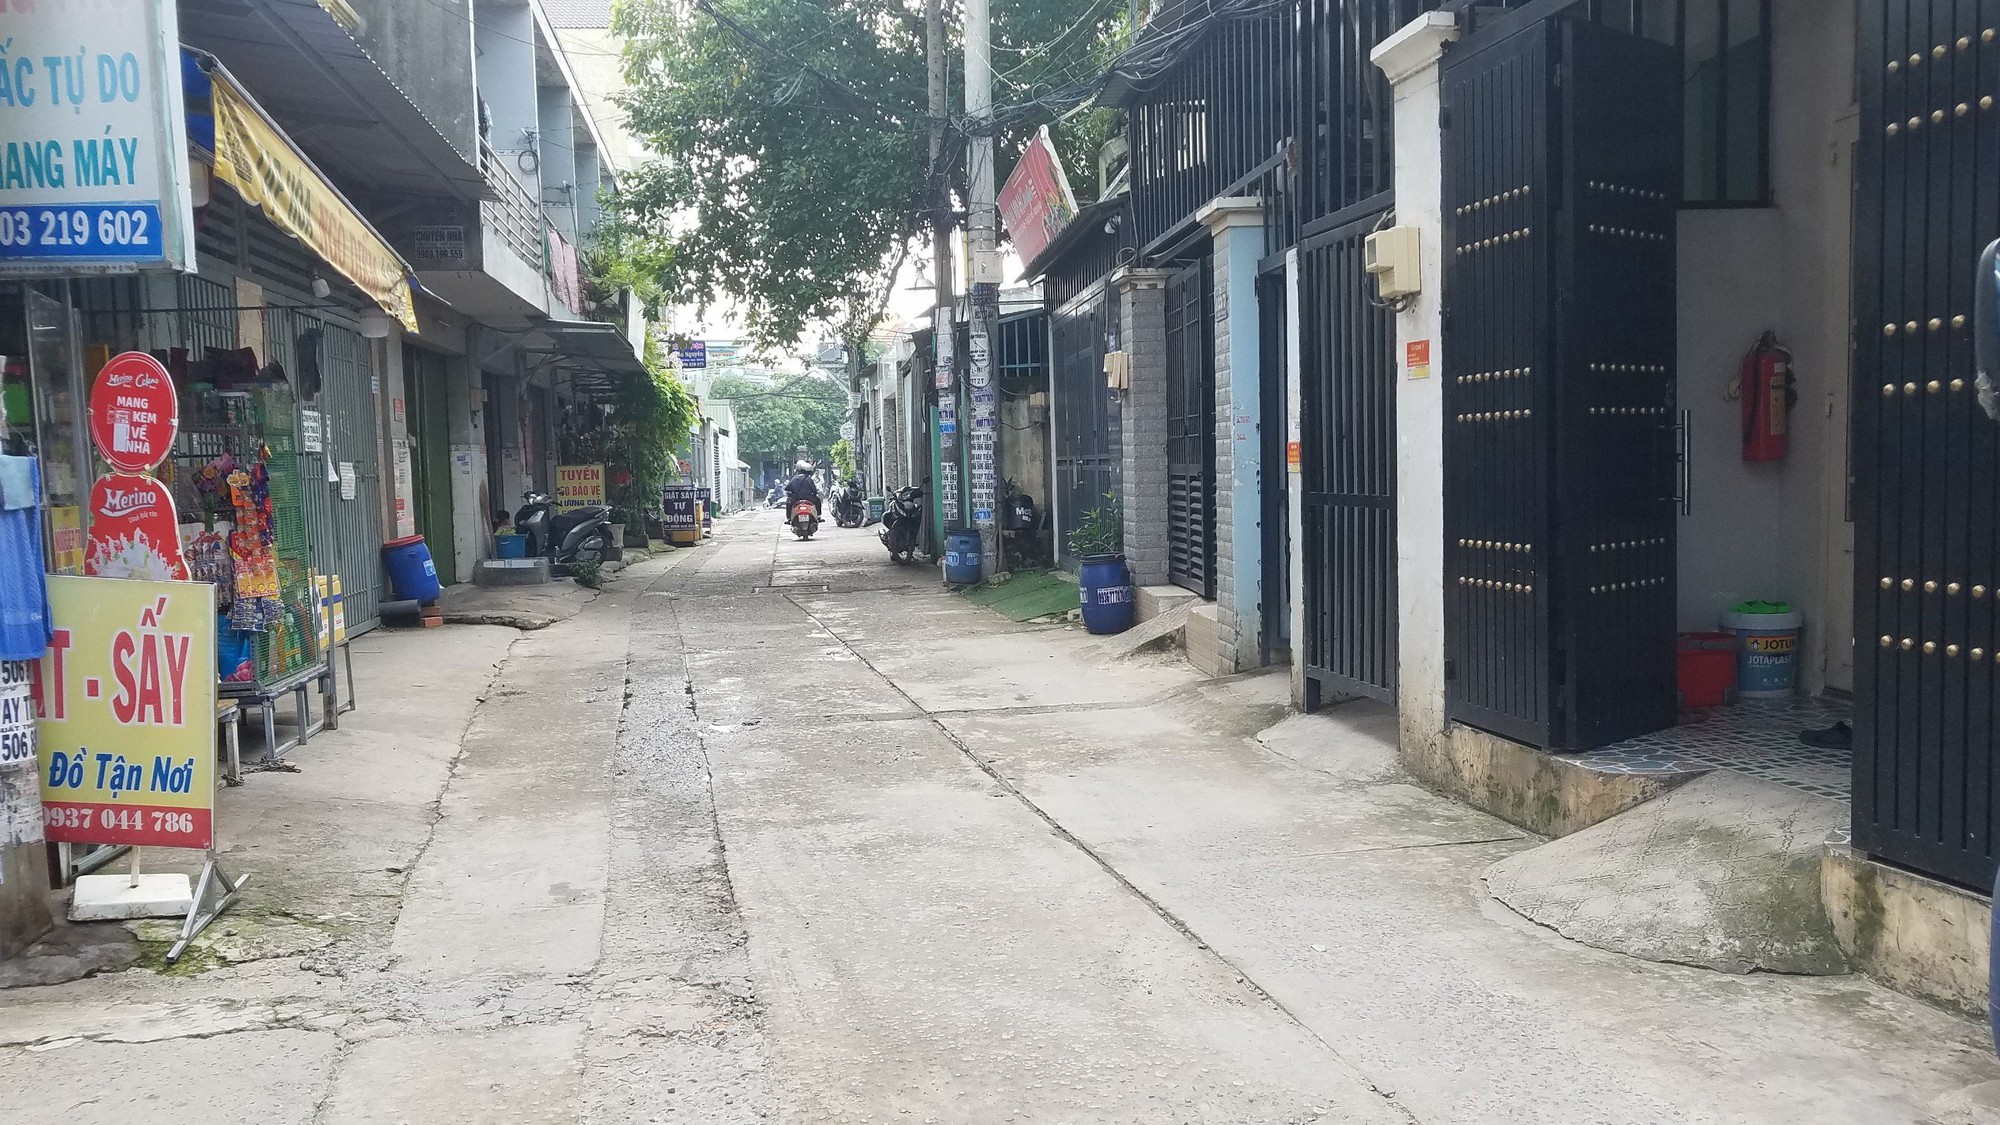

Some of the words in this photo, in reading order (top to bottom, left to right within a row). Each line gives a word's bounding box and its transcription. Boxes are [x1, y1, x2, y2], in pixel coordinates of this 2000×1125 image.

[43, 45, 86, 115] TỰ
[97, 51, 140, 104] DO
[0, 140, 65, 189] ANG
[73, 124, 138, 187] MÁY
[40, 210, 90, 245] 219
[98, 209, 148, 245] 602
[117, 396, 149, 409] MANG
[132, 411, 157, 424] KEM
[103, 487, 157, 512] Merino
[673, 501, 687, 512] TỰ
[112, 597, 190, 725] SẤY
[2, 732, 28, 761] 506
[48, 747, 88, 789] Đồ
[95, 752, 142, 798] Tận
[150, 755, 194, 794] Nơi
[100, 808, 144, 831] 044
[151, 811, 194, 833] 786
